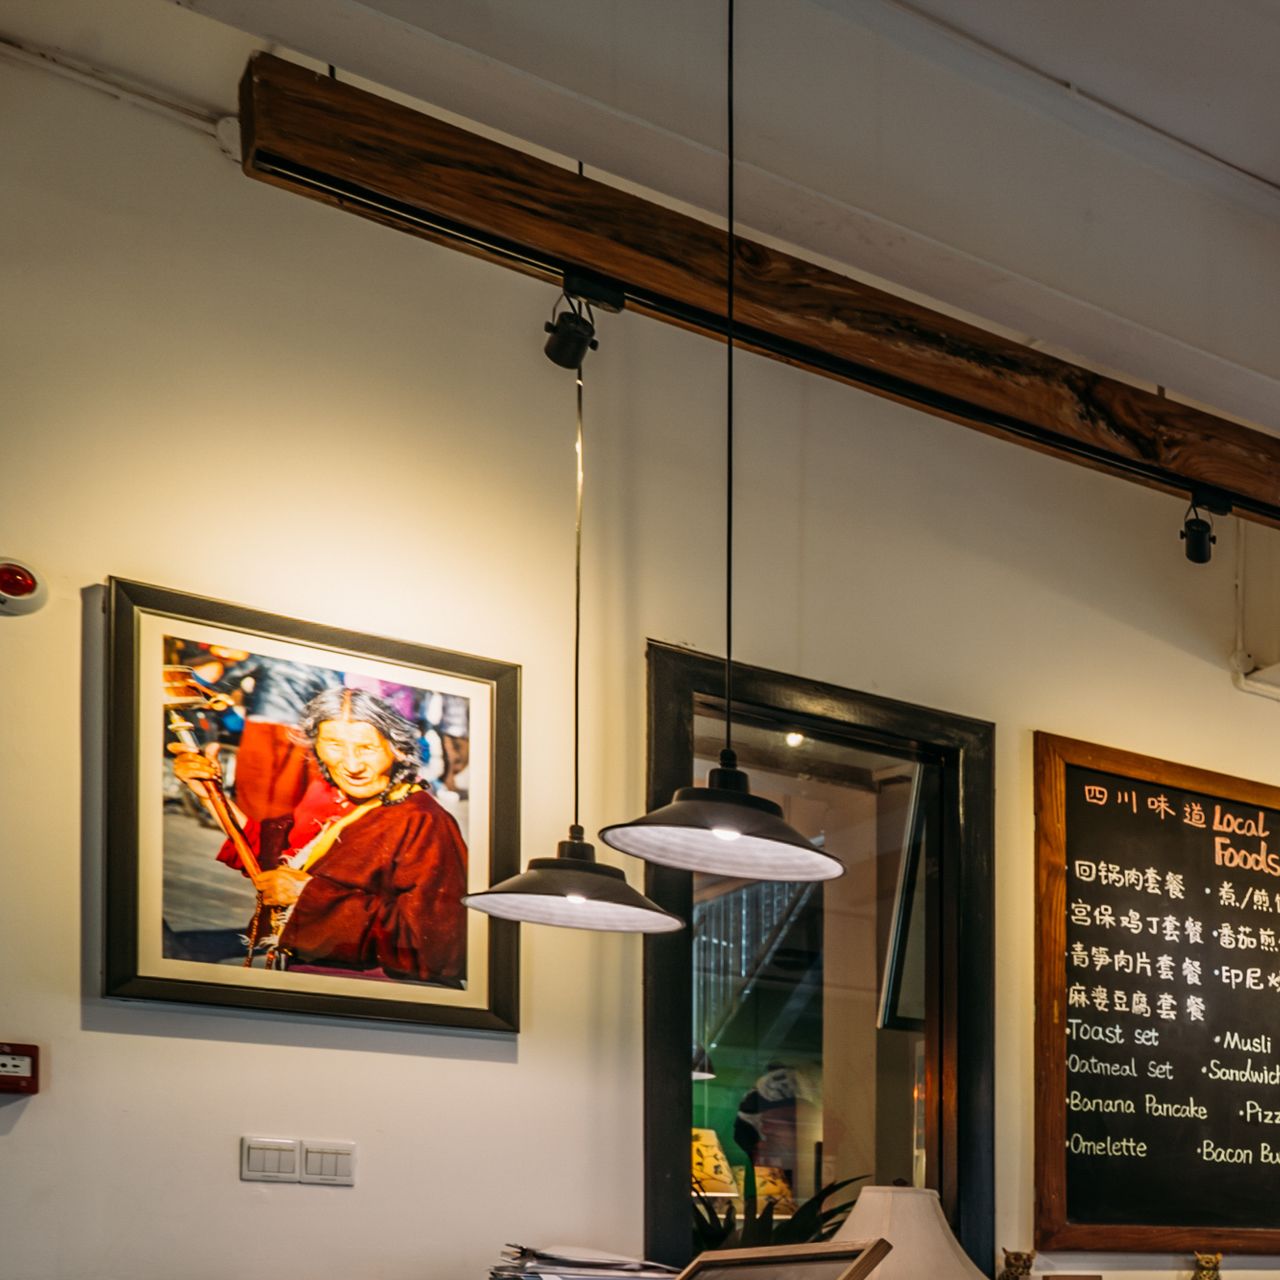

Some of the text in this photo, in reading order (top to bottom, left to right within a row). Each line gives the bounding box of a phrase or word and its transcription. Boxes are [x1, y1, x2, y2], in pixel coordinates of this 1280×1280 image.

[1084, 784, 1207, 828] 四川味道
[1212, 804, 1270, 838] Local
[1074, 859, 1186, 900] 回锅肉套餐
[1070, 898, 1204, 945] 宫保鸡丁套餐
[1068, 981, 1207, 1023] 麻婆豆腐套餐
[1068, 1018, 1125, 1045] Toast
[1223, 1031, 1272, 1054] Musli
[1068, 1054, 1138, 1077] Oatmeal
[1070, 1091, 1208, 1120] Banana Pancake
[1070, 1133, 1148, 1158] Omelette
[1202, 1139, 1252, 1165] Bacon
